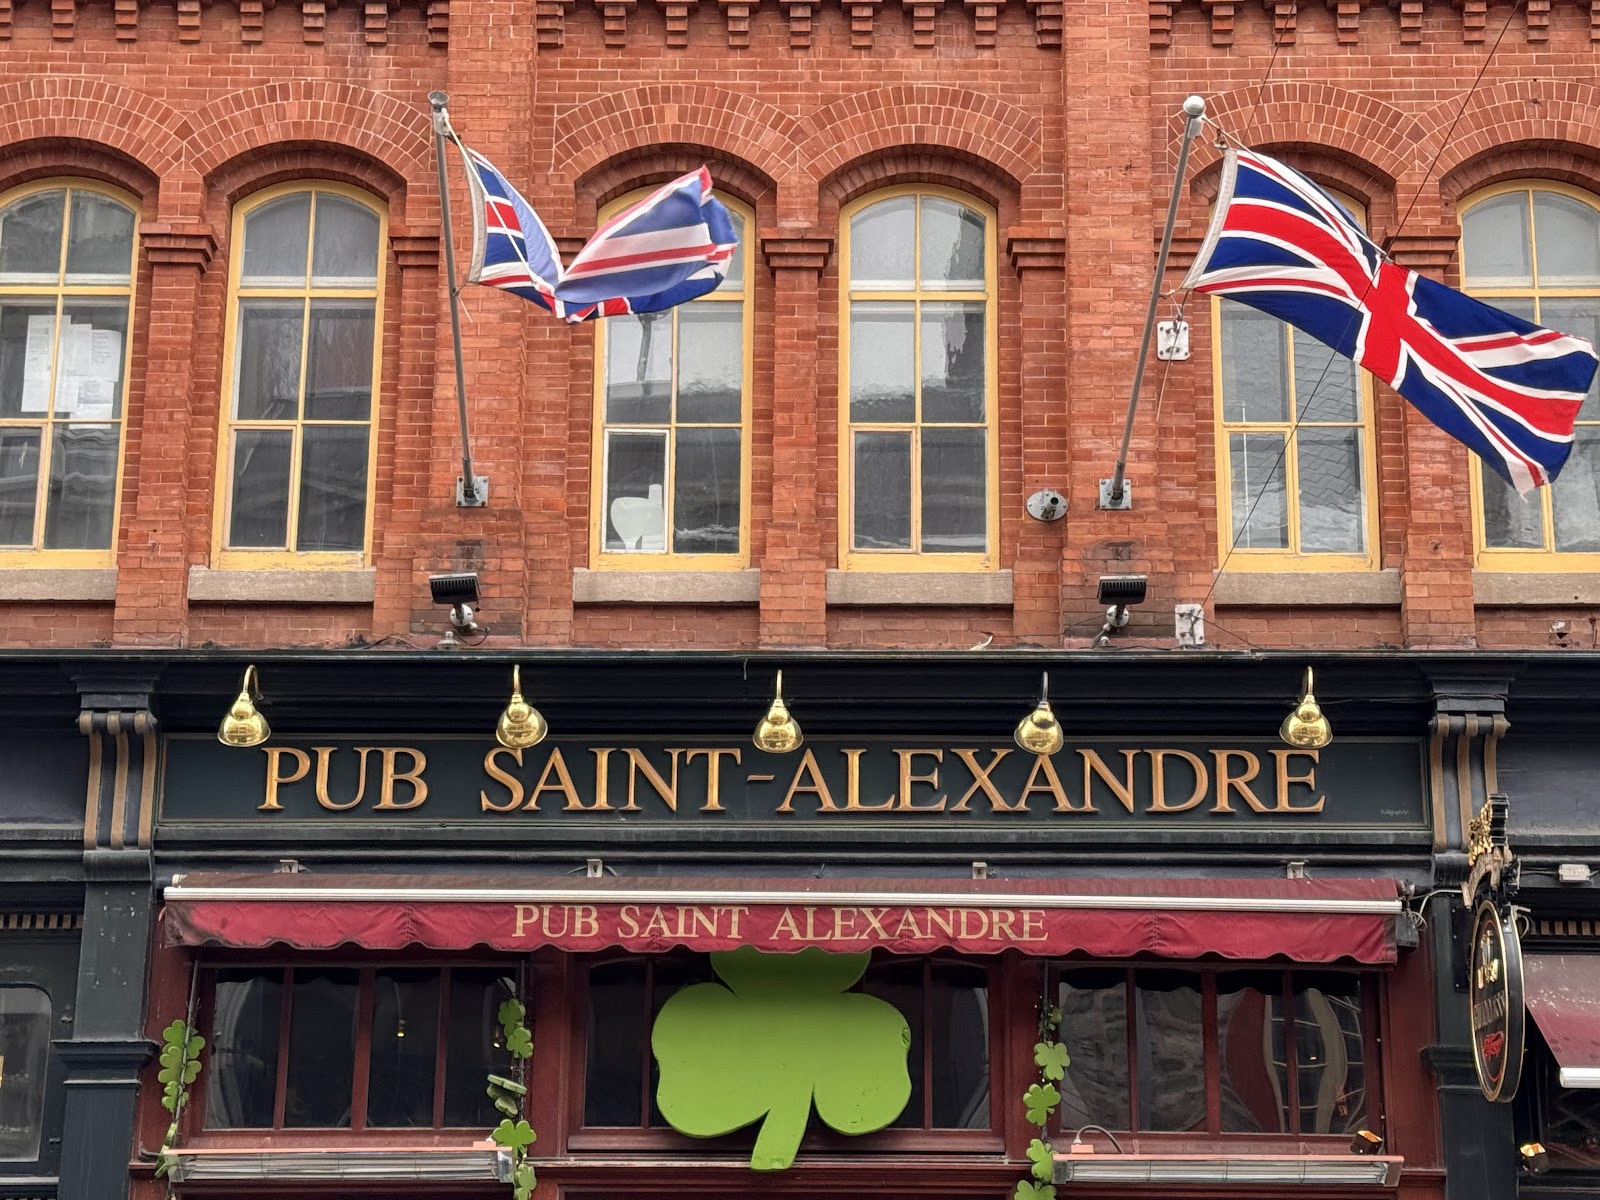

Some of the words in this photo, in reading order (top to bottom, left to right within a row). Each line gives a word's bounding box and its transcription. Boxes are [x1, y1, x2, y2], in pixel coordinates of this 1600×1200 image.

[257, 746, 429, 811] PUB
[479, 746, 1326, 814] SAINT-ALEXANDRE
[512, 904, 600, 938] PUB
[617, 905, 750, 940] SAINT
[768, 906, 1049, 942] ALEXANDRE
